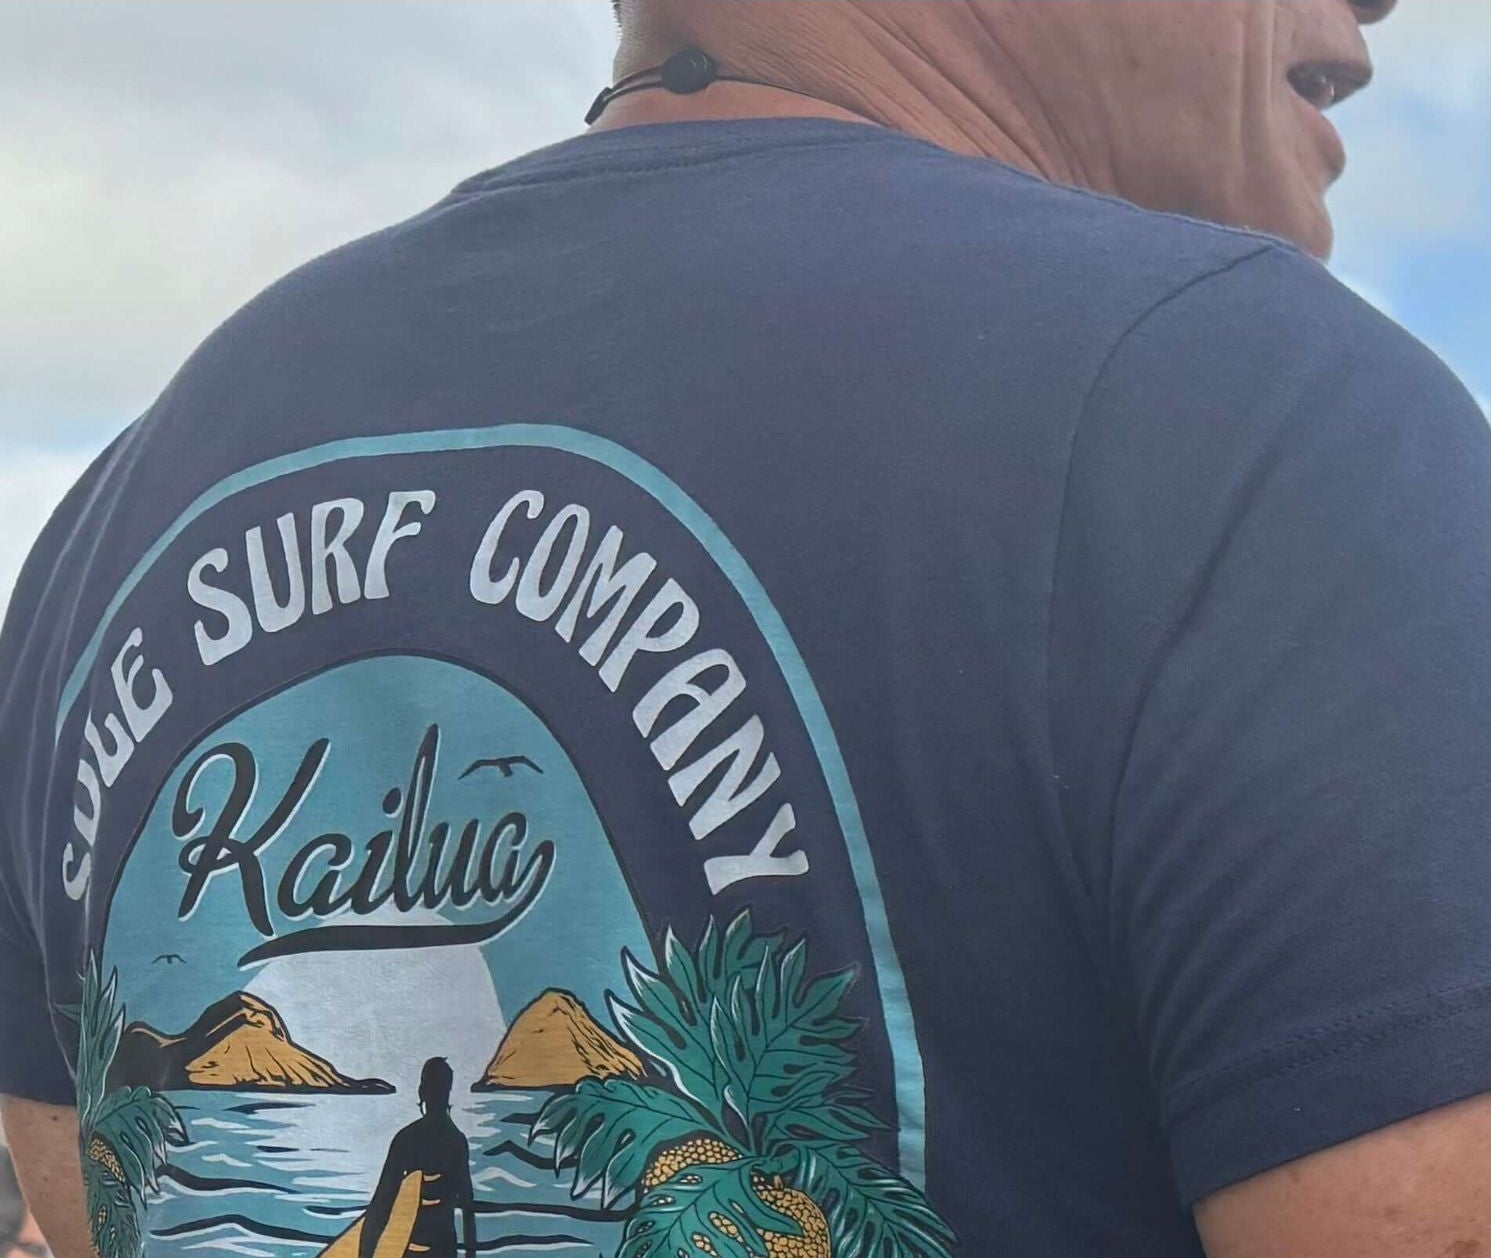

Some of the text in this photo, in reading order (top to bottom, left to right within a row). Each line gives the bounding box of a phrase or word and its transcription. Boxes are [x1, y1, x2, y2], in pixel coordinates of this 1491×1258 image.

[172, 723, 556, 970] Kailua
[187, 490, 437, 666] SURF
[470, 489, 809, 895] COMPANY
